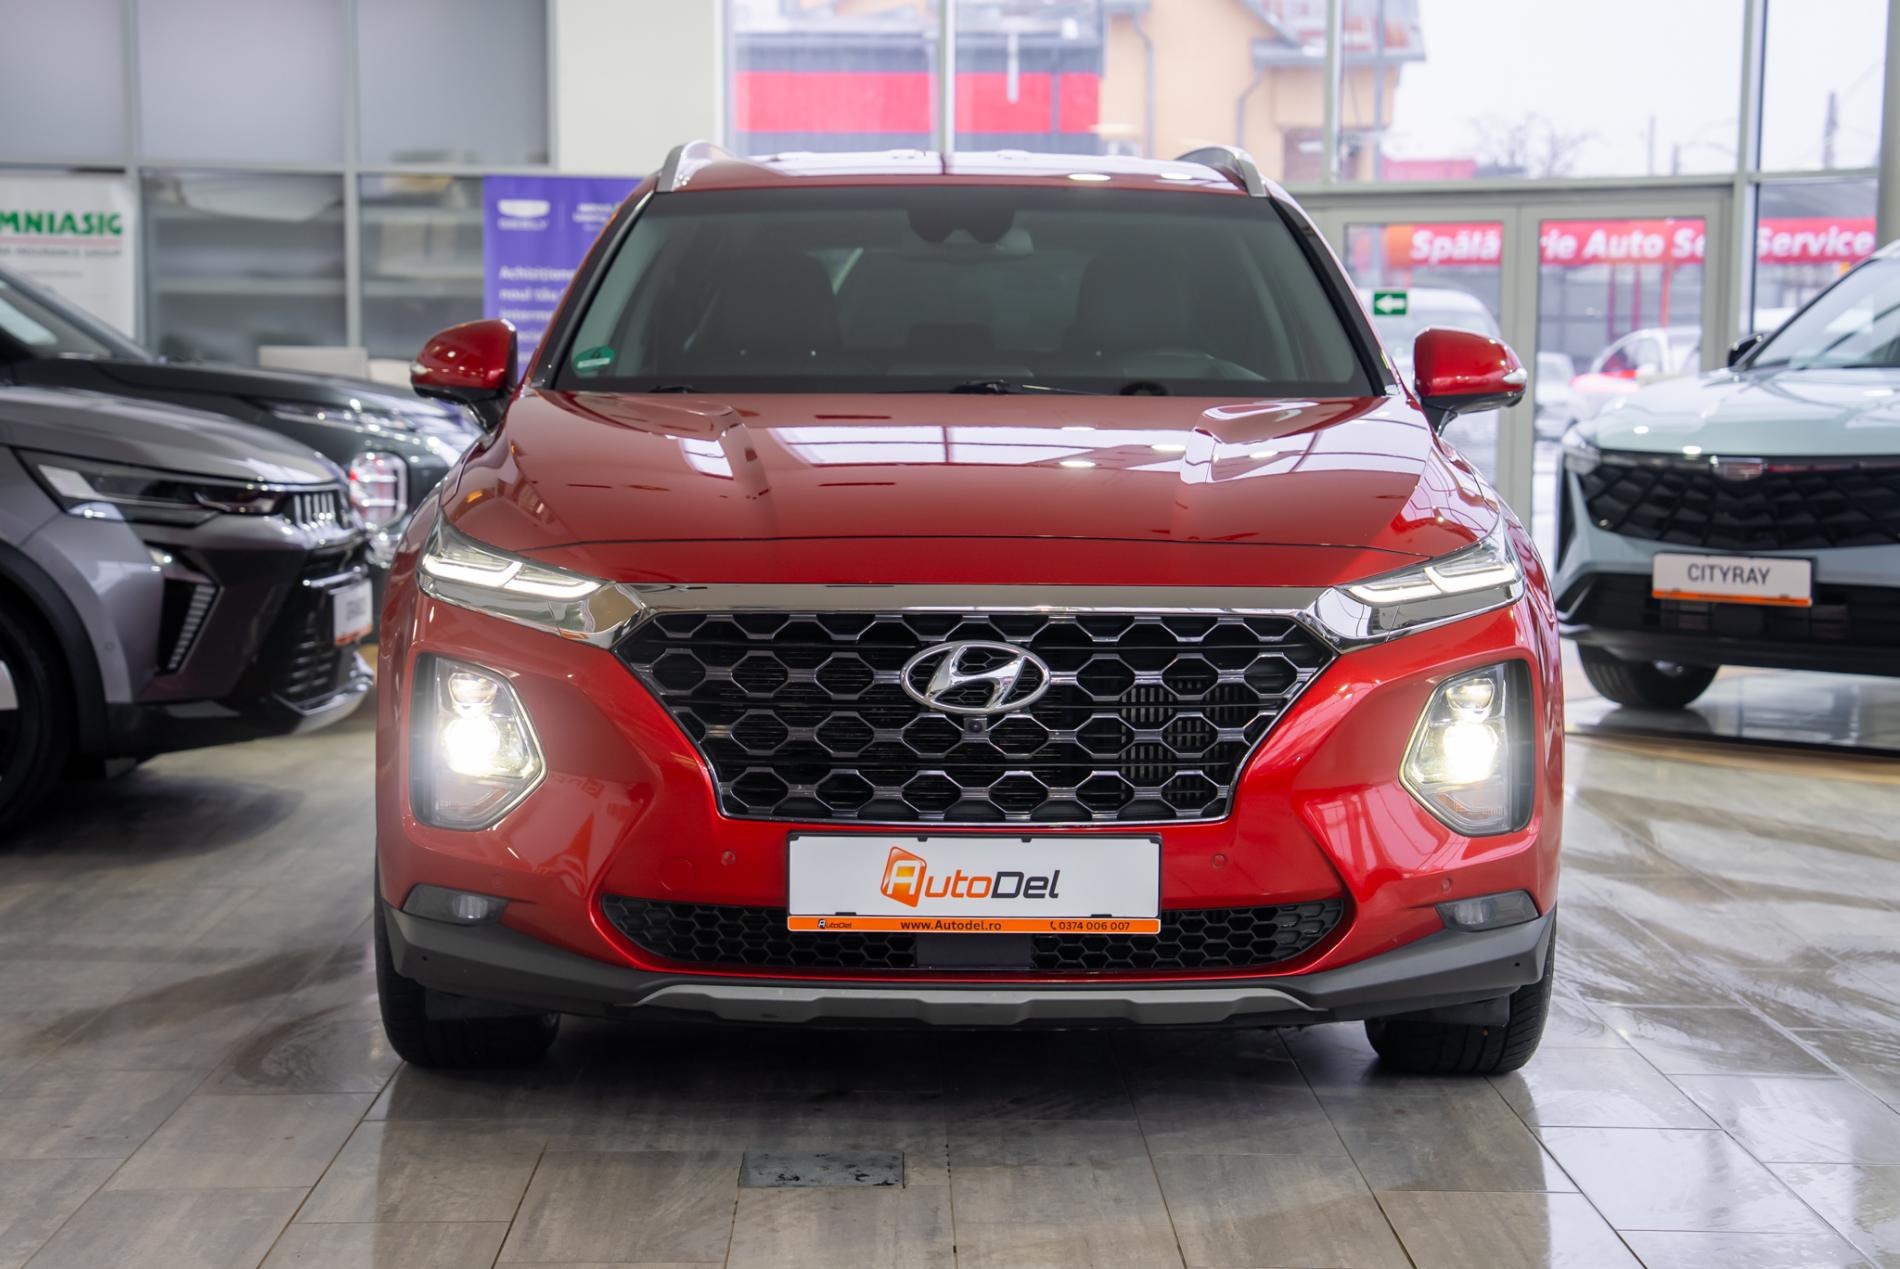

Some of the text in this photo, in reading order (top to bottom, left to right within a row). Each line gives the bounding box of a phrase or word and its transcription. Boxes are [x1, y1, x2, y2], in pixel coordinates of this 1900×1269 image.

[1582, 229, 1664, 259] Auto
[1687, 563, 1771, 585] CITYRAY
[884, 857, 1061, 900] AutoDel
[818, 918, 852, 930] AutoDel
[900, 919, 1002, 931] www.Autodel.ro
[1058, 921, 1131, 931] 0374 006 007
